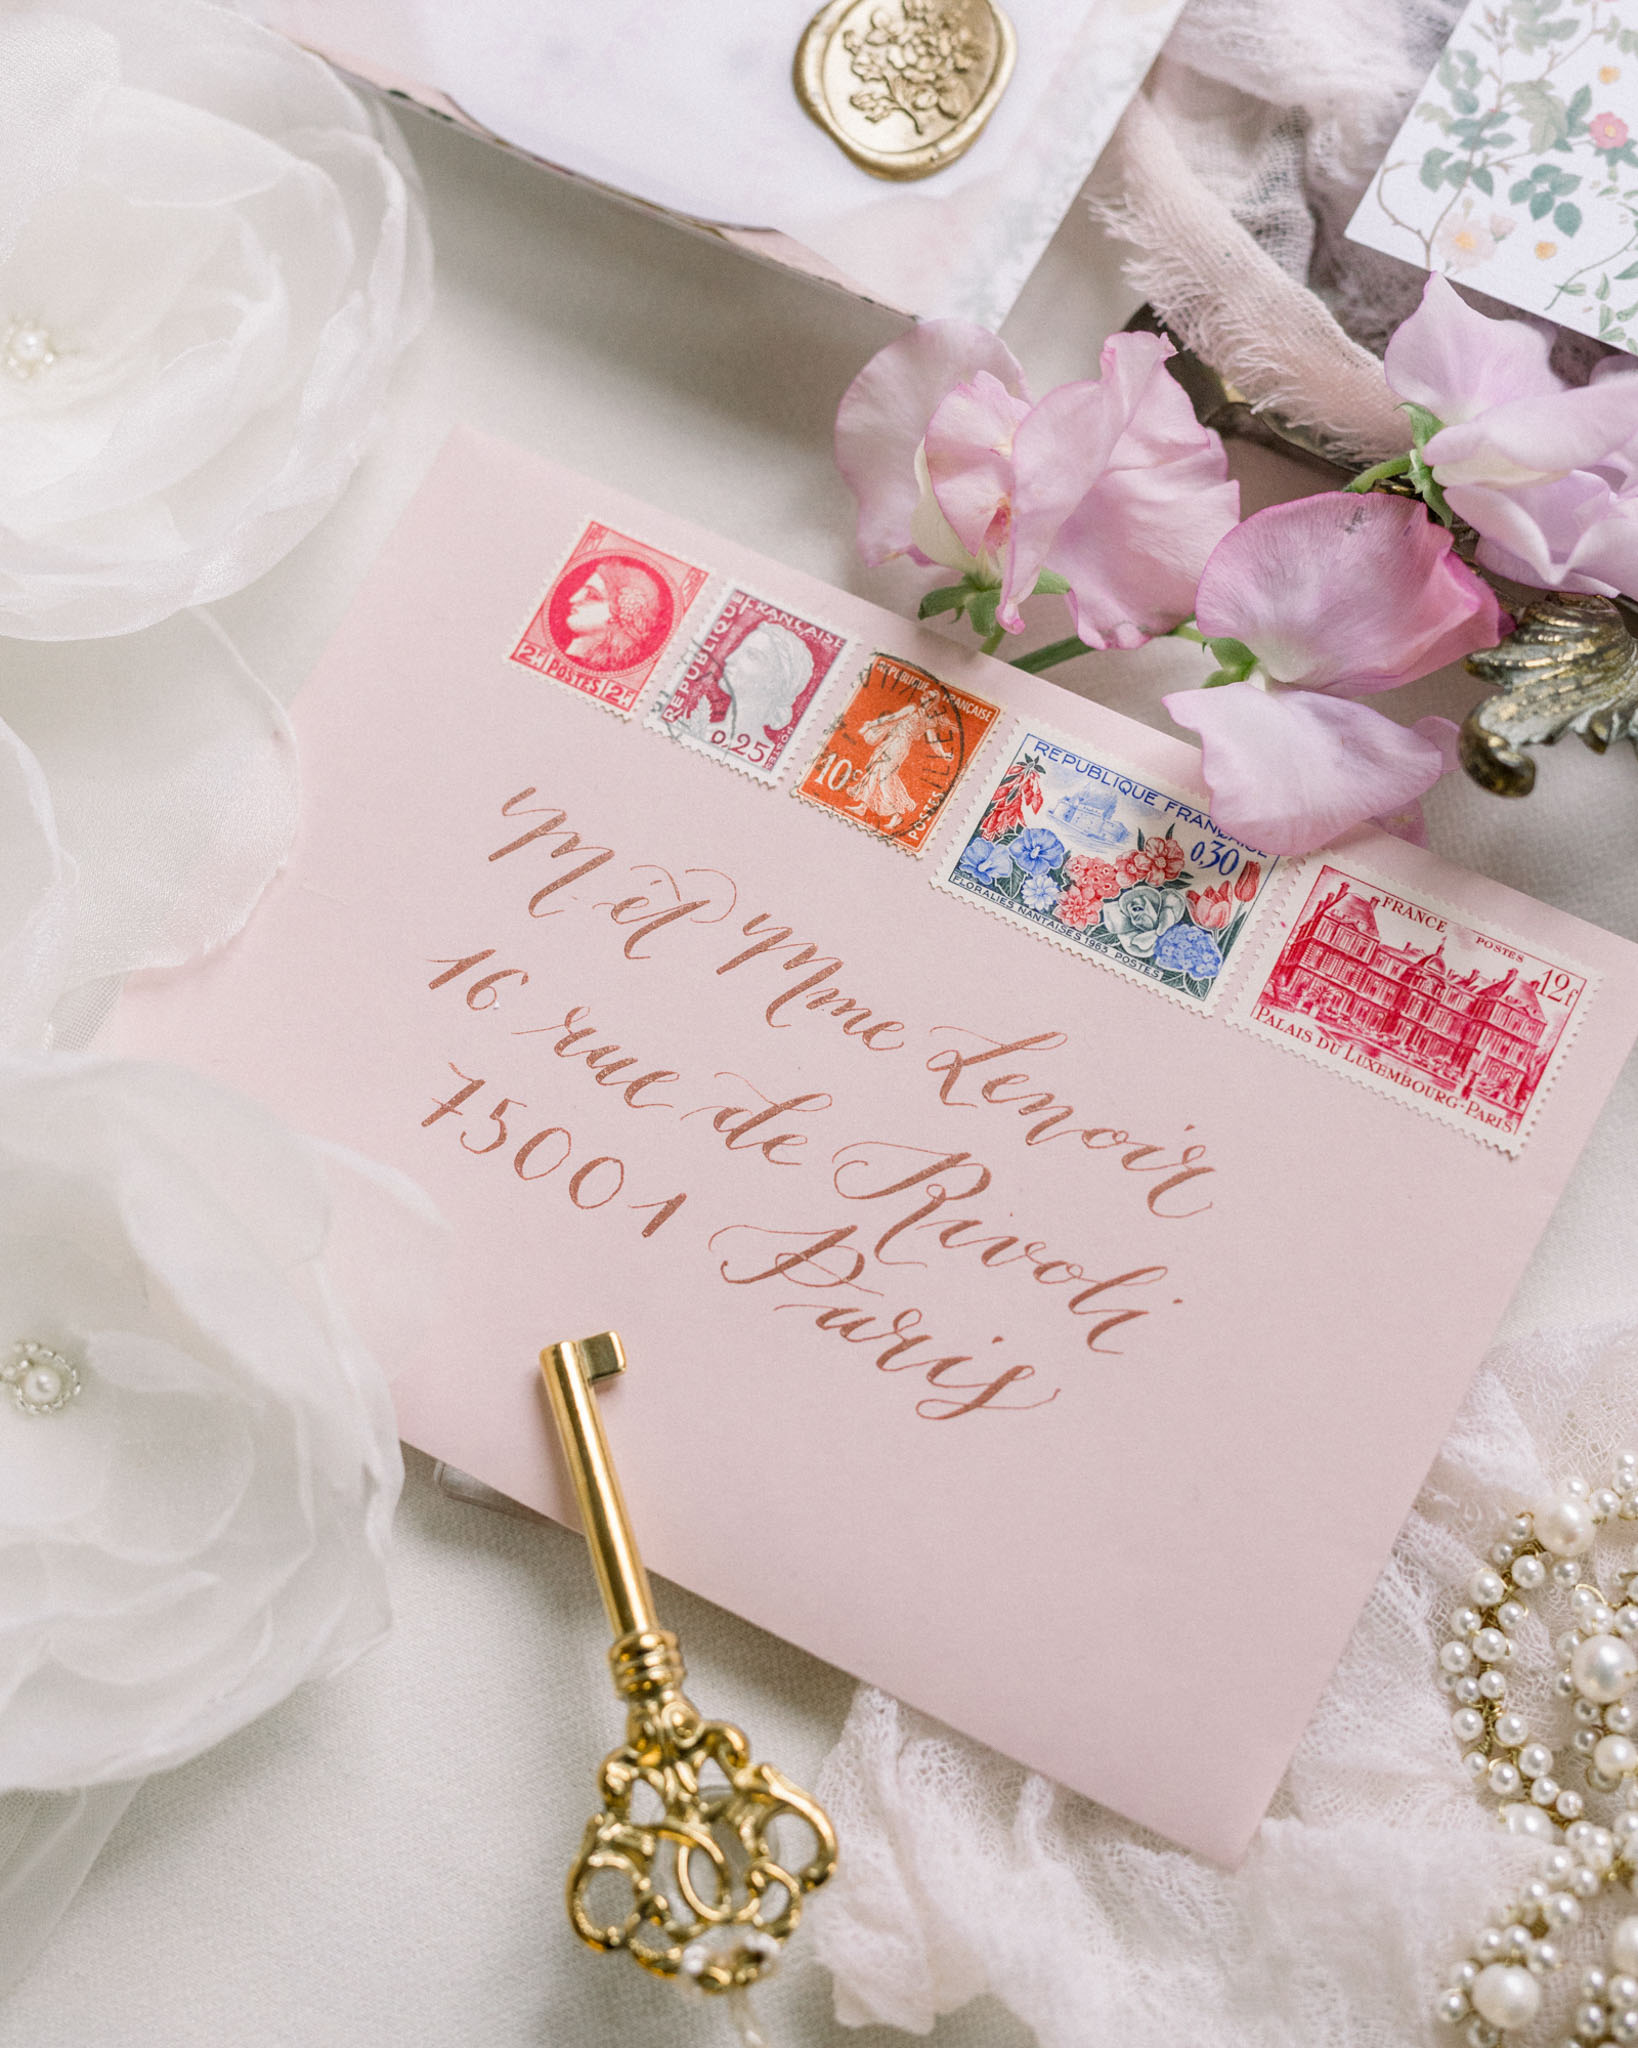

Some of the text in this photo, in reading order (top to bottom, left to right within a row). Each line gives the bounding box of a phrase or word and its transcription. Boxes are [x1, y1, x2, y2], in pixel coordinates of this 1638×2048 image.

[547, 659, 602, 693] POSTES
[662, 592, 746, 721] REPUBLIQUE
[711, 730, 770, 762] 0,25
[1033, 741, 1158, 806] REPUBLIQUE
[908, 791, 945, 840] POSTES
[1190, 840, 1239, 876] 0,30
[952, 875, 1161, 979] FLORALIES NANTAISES 1963 POSTES
[1381, 896, 1447, 933] FRANCE
[1475, 936, 1525, 963] POSTES
[716, 911, 905, 1051] Mme
[926, 1025, 1216, 1218] Lenoir
[425, 948, 1184, 1355] 16 rue de Rivoli
[421, 1062, 1062, 1420] 75001 Paris
